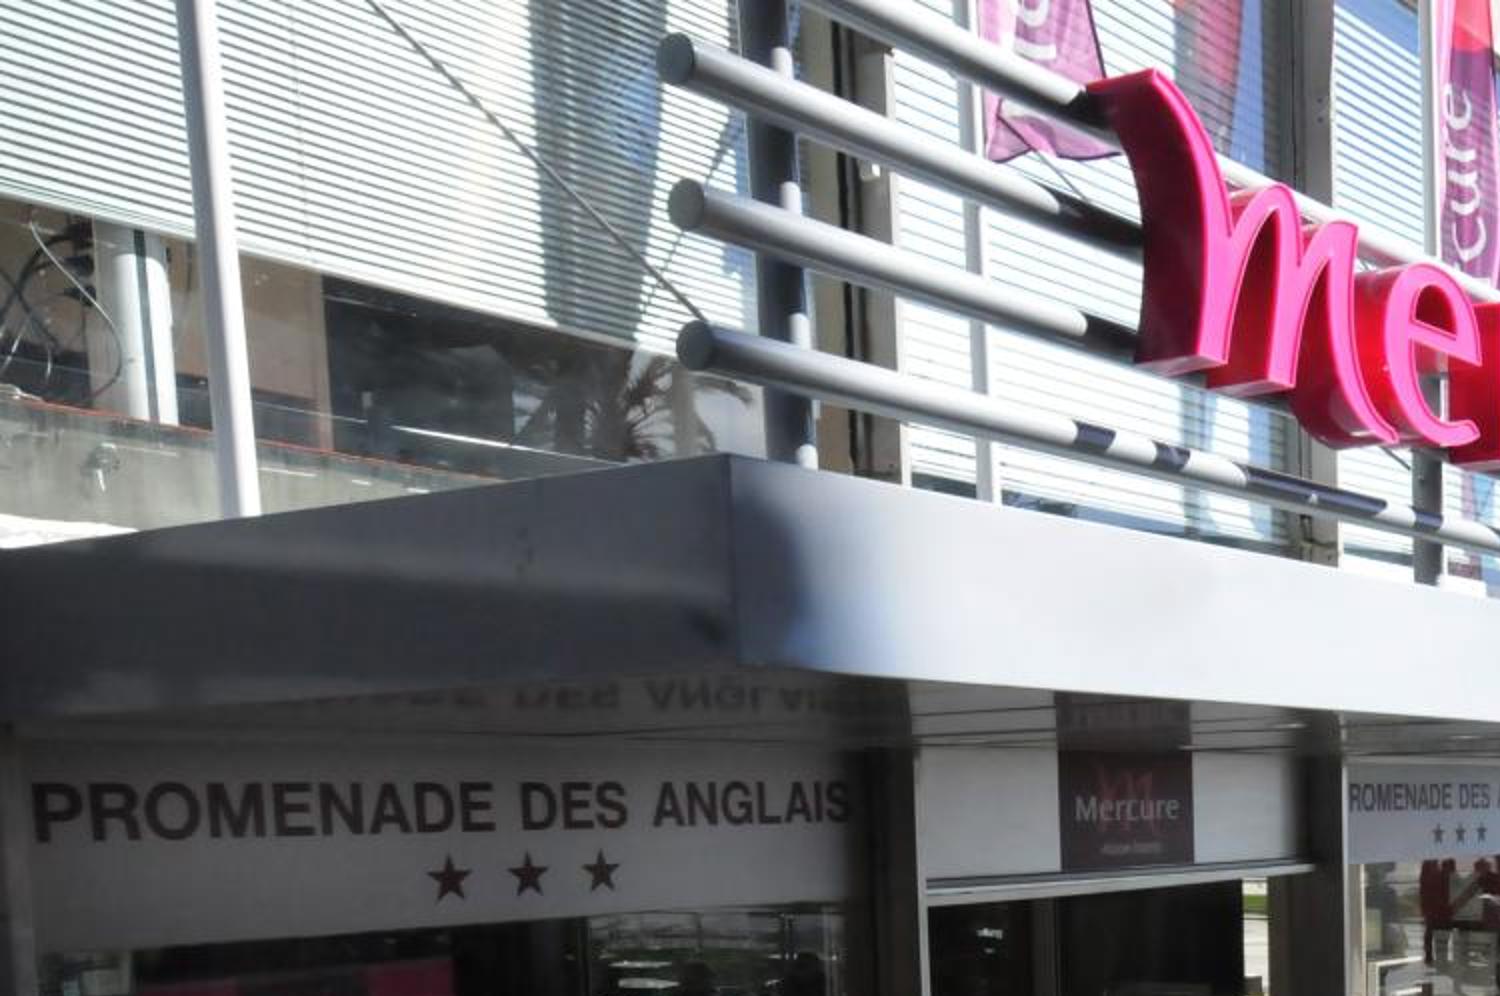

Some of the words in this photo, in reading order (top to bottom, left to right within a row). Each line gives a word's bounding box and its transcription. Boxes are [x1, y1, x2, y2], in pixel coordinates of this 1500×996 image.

[31, 781, 497, 843] PROMENADE
[519, 780, 629, 831] DES
[652, 780, 853, 828] ANGLAIS
[1074, 796, 1180, 822] Mercure
[1348, 783, 1454, 812] ROMENADE
[1458, 783, 1491, 809] DES
